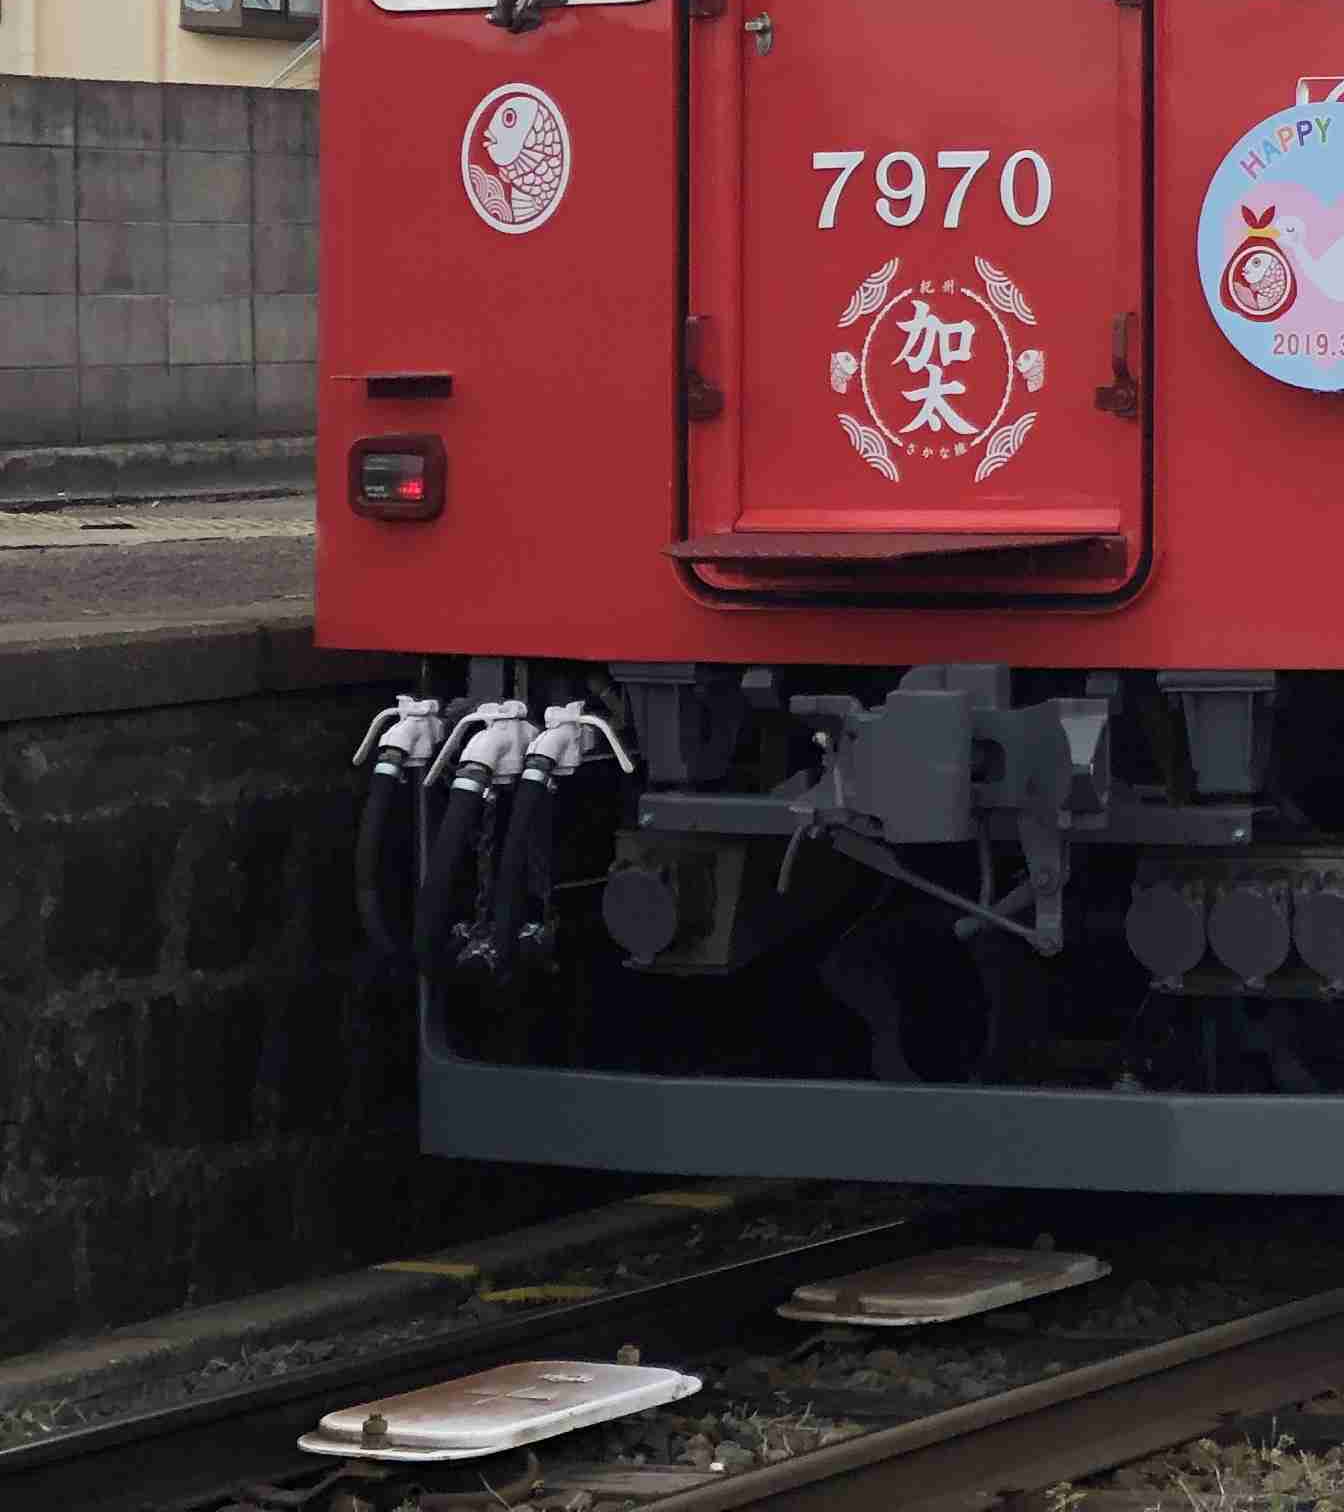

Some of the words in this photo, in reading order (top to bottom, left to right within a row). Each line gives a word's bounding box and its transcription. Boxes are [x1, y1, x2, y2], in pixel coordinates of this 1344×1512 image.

[1239, 117, 1331, 180] HAPPY
[812, 149, 1053, 229] 7970
[891, 299, 983, 435] 加太
